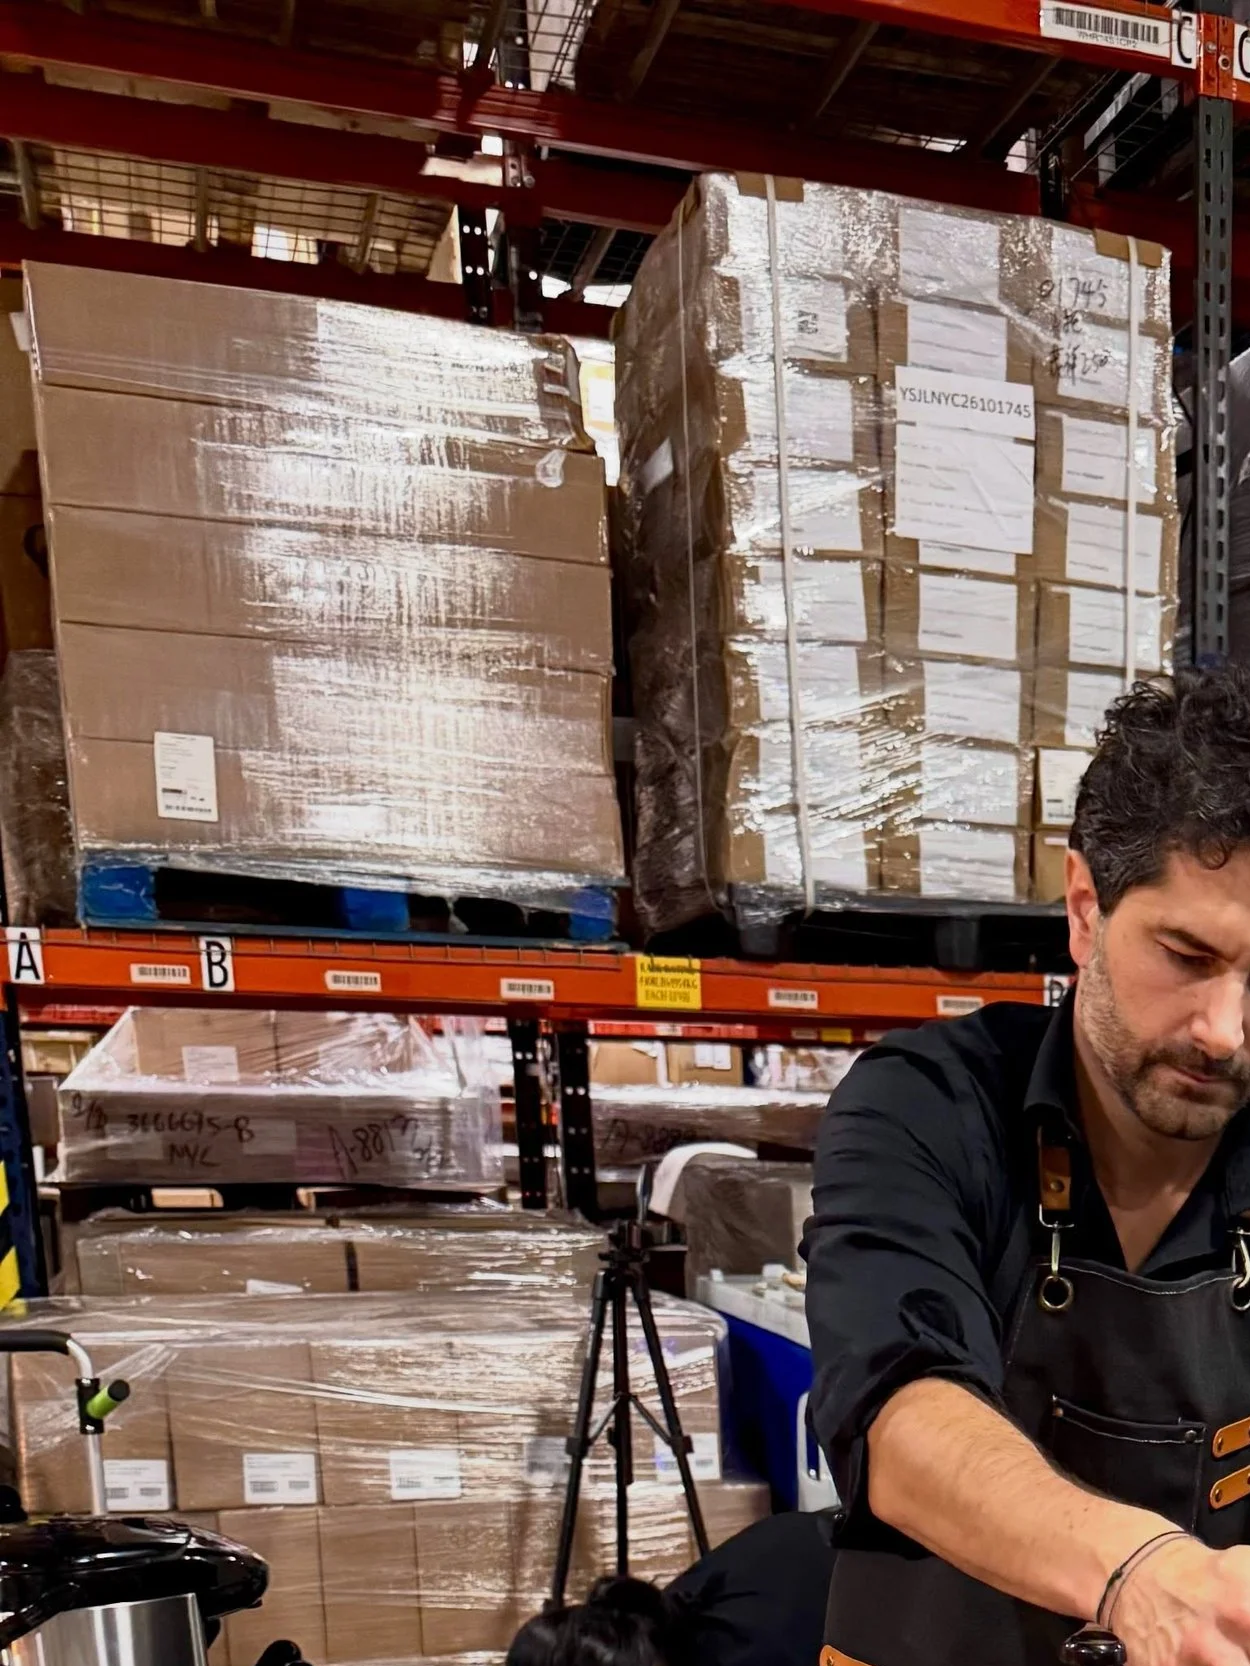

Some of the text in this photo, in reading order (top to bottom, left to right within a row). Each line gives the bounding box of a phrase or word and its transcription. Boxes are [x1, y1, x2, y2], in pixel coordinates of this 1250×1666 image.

[1177, 16, 1193, 63] C
[899, 387, 1032, 419] YSJLNYC26101745
[15, 932, 40, 980] A
[205, 940, 229, 988] B
